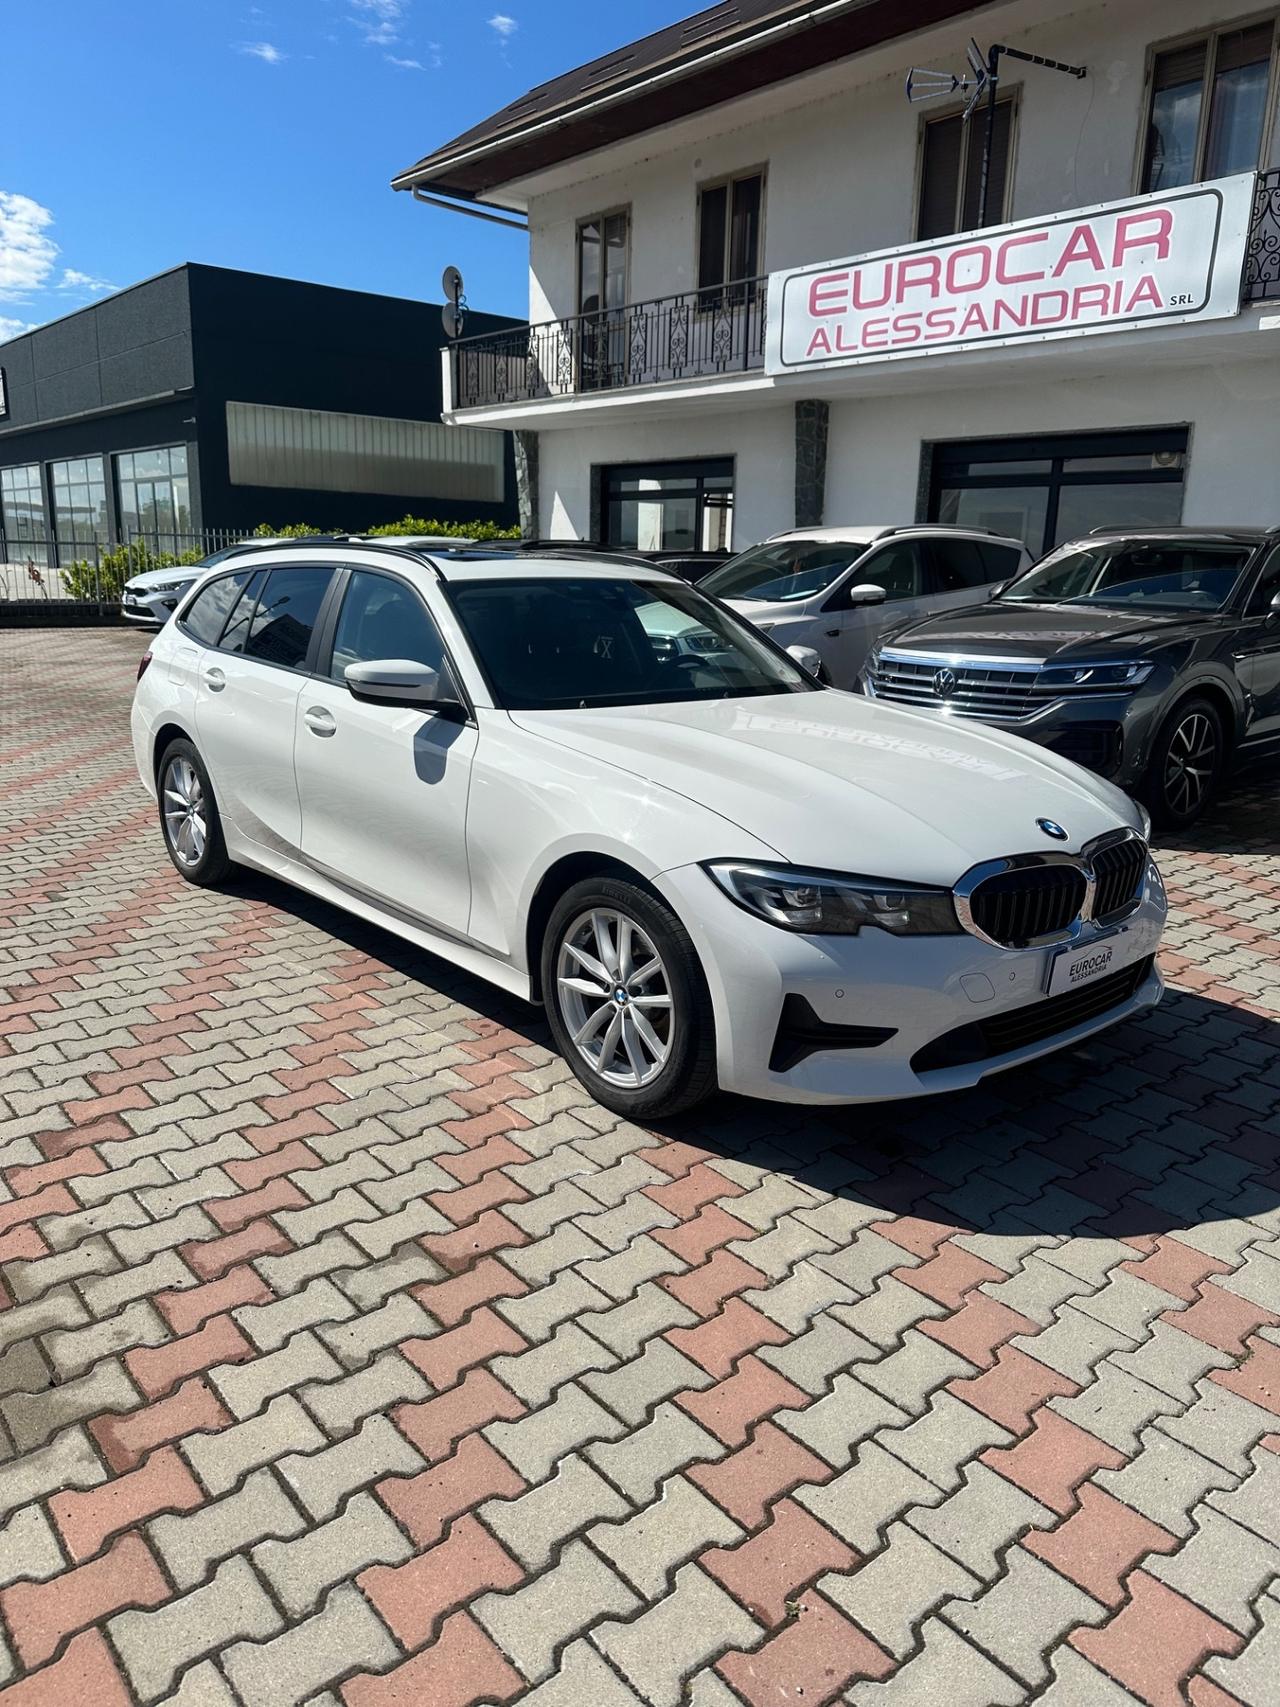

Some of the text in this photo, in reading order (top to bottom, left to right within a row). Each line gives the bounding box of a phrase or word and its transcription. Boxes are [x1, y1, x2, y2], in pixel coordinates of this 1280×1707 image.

[809, 209, 1173, 317] EUROCAR
[806, 276, 1194, 356] ALESSANDRIA SRL
[1069, 951, 1112, 976] EUROCAR
